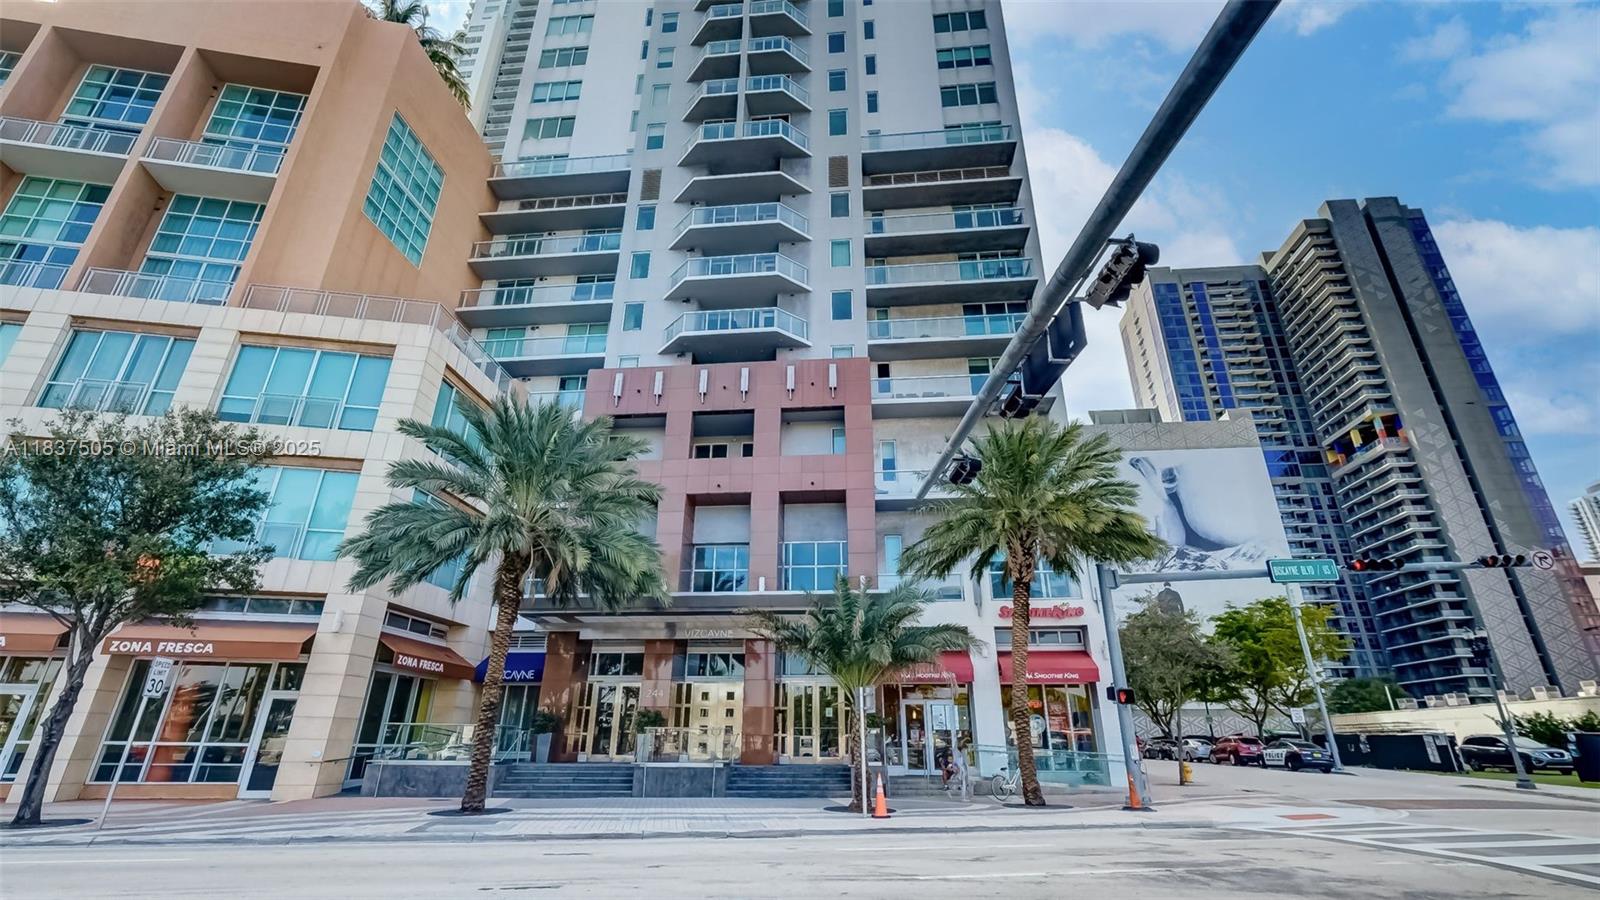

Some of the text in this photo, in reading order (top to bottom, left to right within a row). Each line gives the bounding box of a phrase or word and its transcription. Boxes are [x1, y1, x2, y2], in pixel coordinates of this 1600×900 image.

[1300, 565, 1315, 576] BLVD
[684, 629, 734, 638] VIZCAYNE
[109, 640, 214, 654] ZONA FRESCA
[397, 654, 444, 673] ZONA FRESCA
[146, 678, 164, 693] 30
[646, 689, 664, 698] 244
